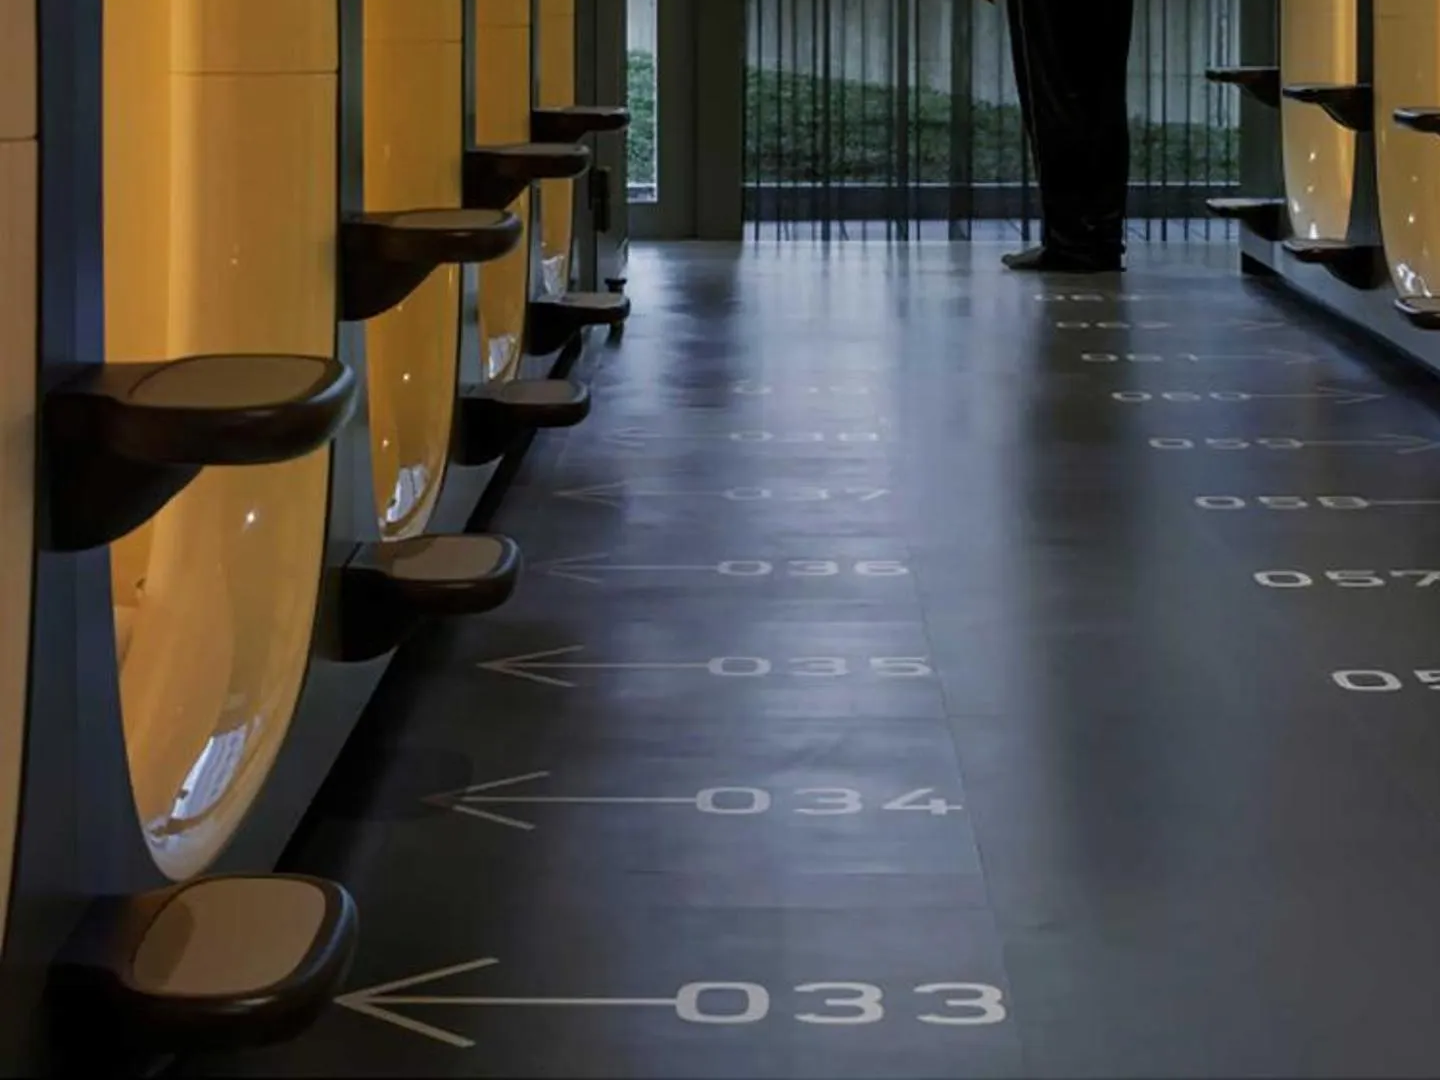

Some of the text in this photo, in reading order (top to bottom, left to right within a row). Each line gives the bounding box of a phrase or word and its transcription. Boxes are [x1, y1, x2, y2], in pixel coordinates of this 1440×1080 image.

[722, 485, 893, 502] 037
[716, 560, 910, 576] 036
[707, 655, 933, 678] 035
[694, 786, 963, 816] 034
[674, 980, 1008, 1026] 033
